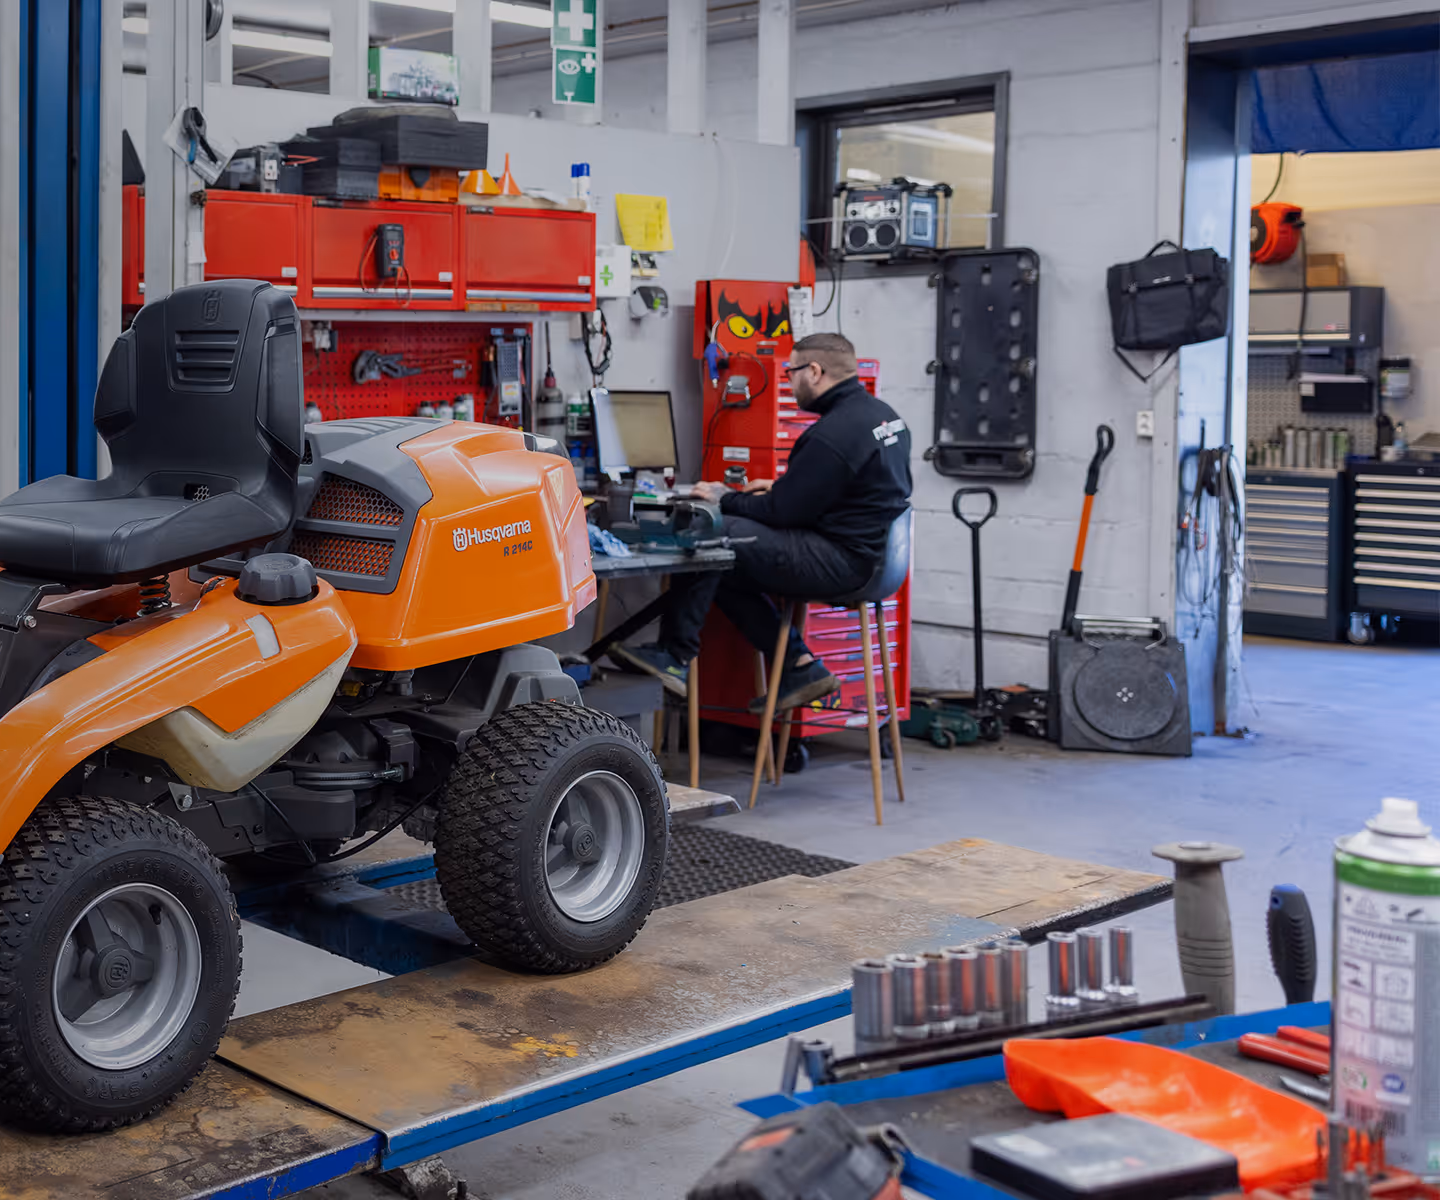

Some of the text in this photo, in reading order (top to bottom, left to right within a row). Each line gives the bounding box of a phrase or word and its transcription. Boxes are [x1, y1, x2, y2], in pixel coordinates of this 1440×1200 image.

[467, 520, 531, 545] Husqvarna
[504, 541, 532, 556] R 214C
